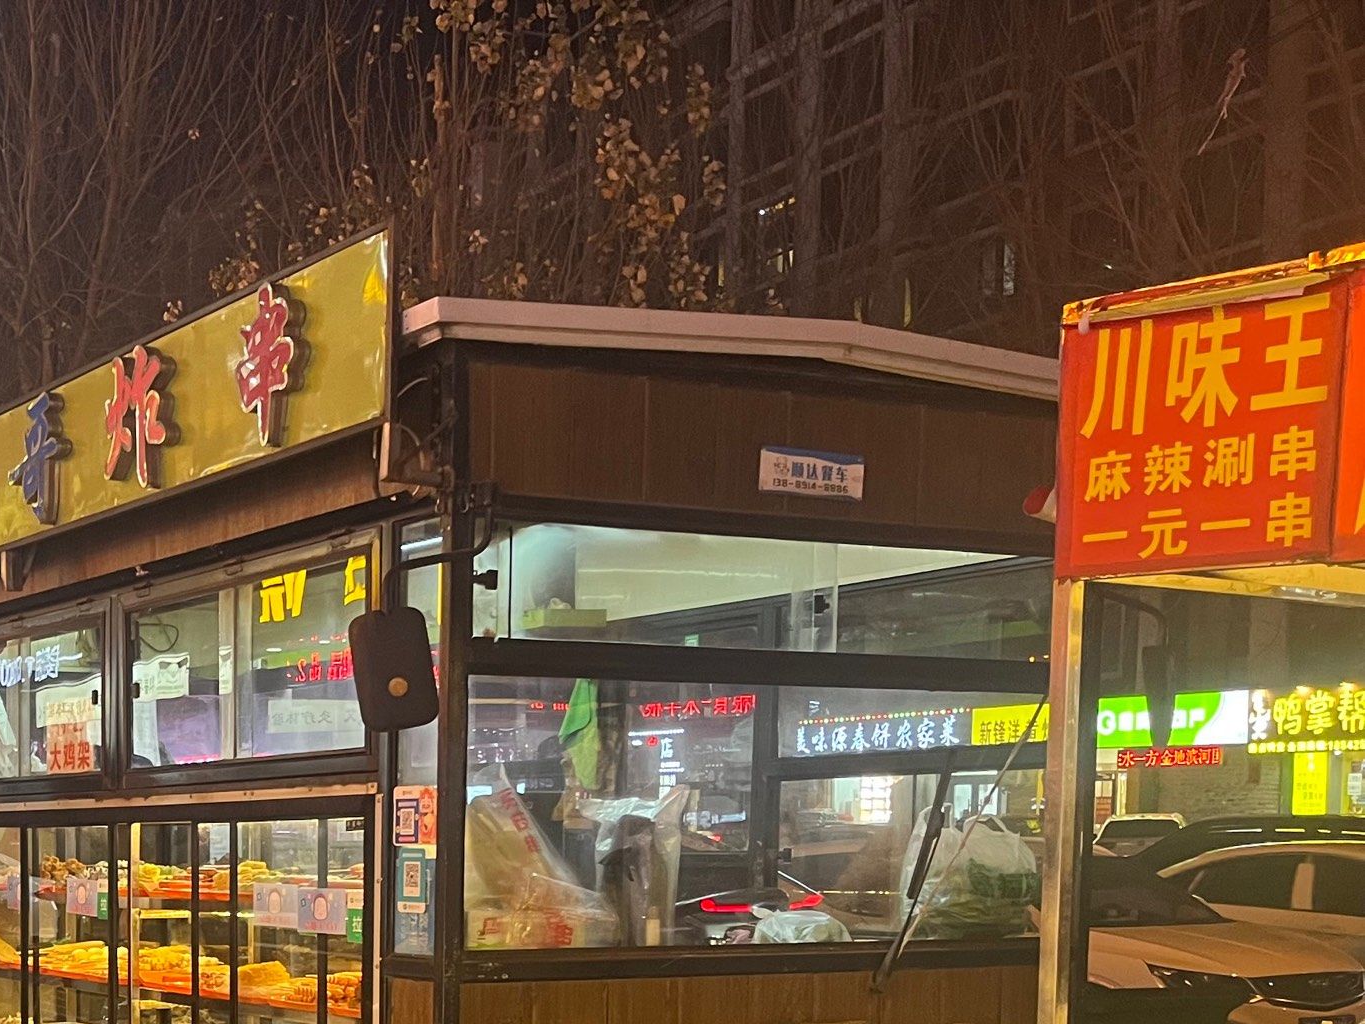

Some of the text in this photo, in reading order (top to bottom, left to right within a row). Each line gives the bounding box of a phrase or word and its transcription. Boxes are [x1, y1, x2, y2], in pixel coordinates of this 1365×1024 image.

[1080, 292, 1330, 439] 川味王
[1084, 425, 1317, 503] 麻辣涮串
[1082, 492, 1313, 559] 一元一串
[49, 740, 90, 771] 大鸡架
